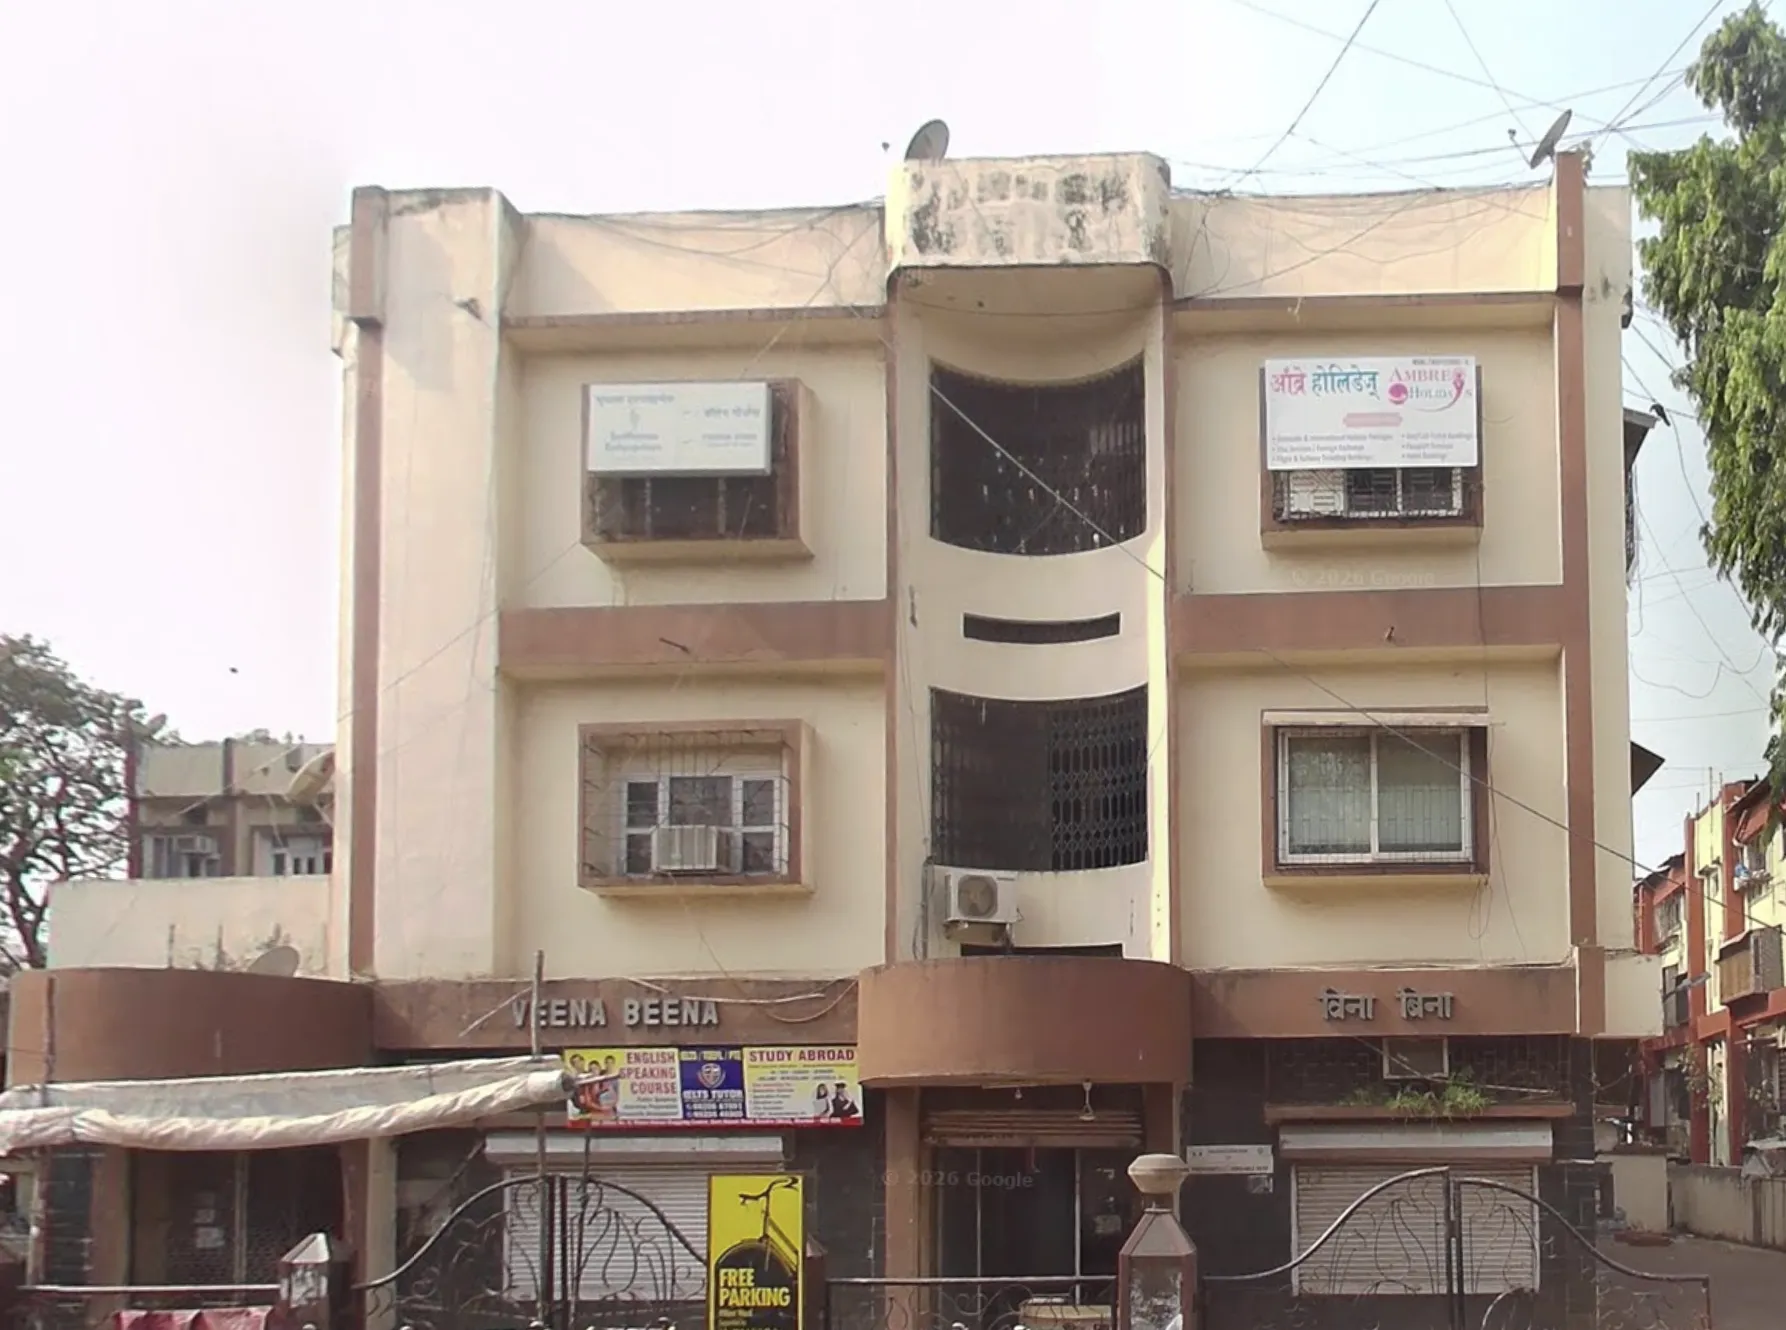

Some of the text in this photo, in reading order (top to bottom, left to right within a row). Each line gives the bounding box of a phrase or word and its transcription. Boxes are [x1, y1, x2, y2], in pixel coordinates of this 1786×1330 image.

[512, 1000, 718, 1026] VEENA BEENA
[627, 1052, 675, 1063] ENGLISH
[749, 1050, 793, 1062] STUDY
[799, 1049, 854, 1061] ABROAD
[620, 1067, 675, 1079] SPEAKING
[631, 1082, 677, 1094] COURSE
[719, 1268, 756, 1287] FREE
[719, 1287, 791, 1308] PARKING
